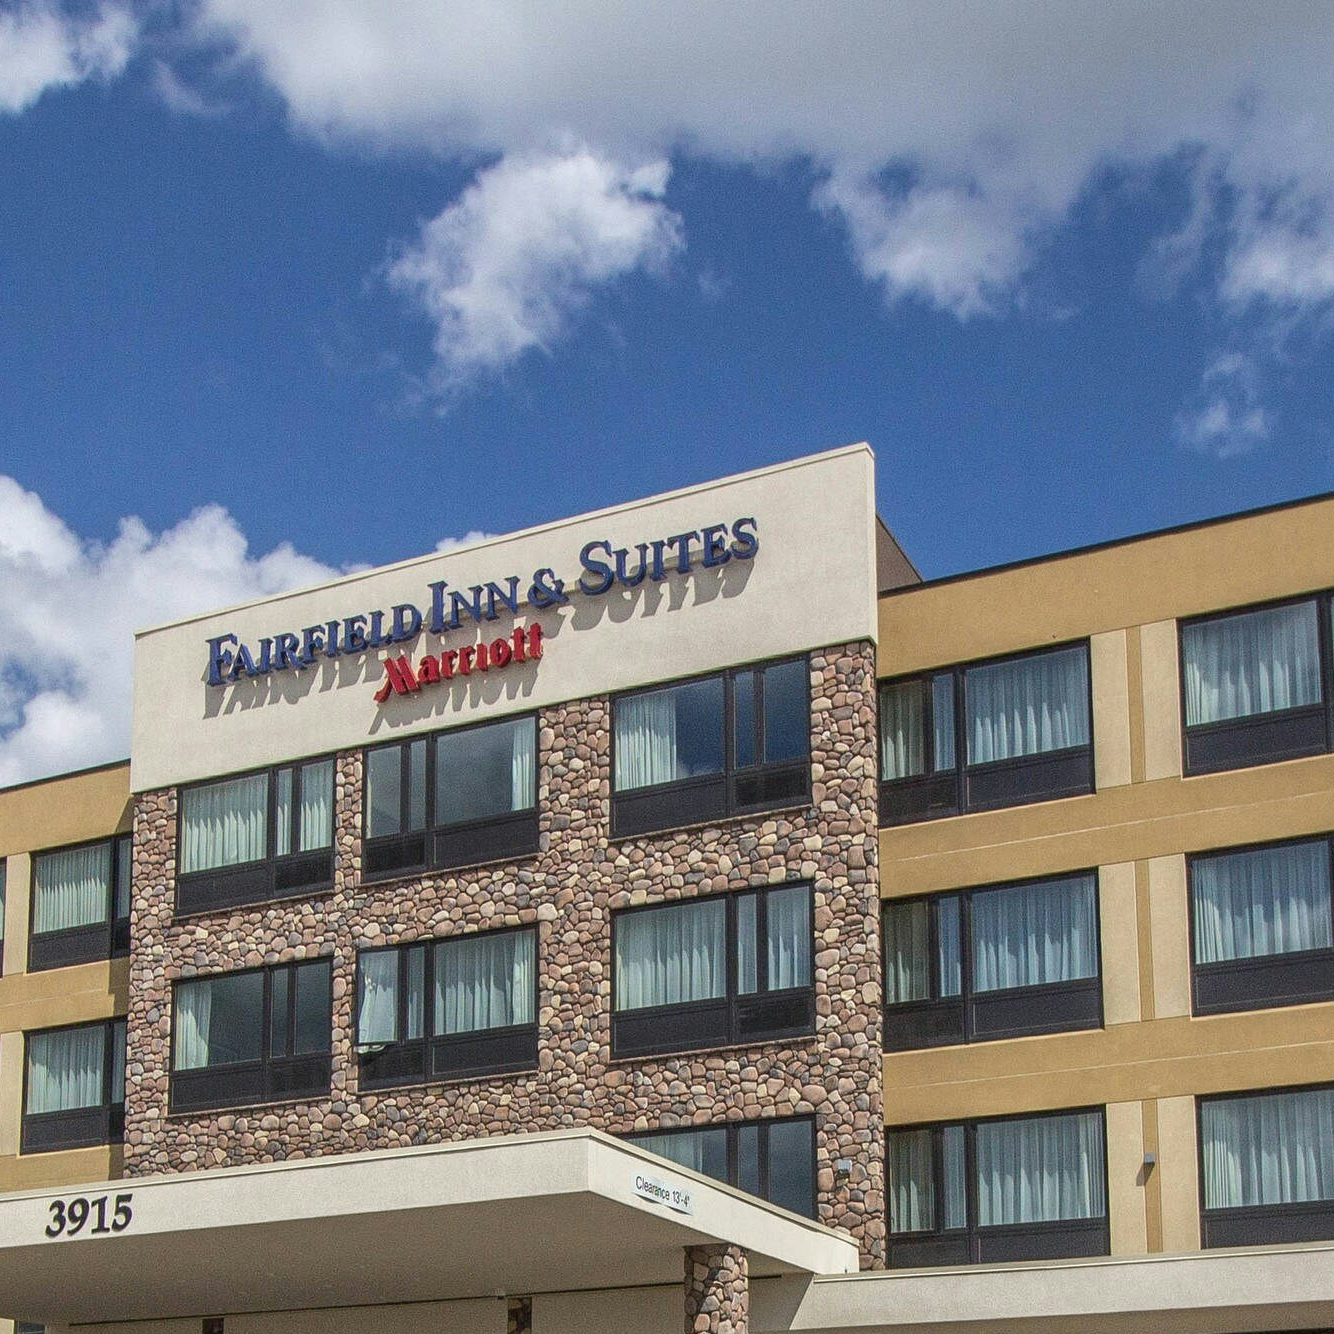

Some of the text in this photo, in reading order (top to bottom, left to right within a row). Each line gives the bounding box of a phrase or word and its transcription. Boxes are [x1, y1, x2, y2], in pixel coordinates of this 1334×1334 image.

[205, 517, 759, 686] FAIRFIELD INN & SUITES
[374, 622, 544, 703] Marriott
[45, 1193, 133, 1238] 3915
[635, 1175, 670, 1200] Clearance
